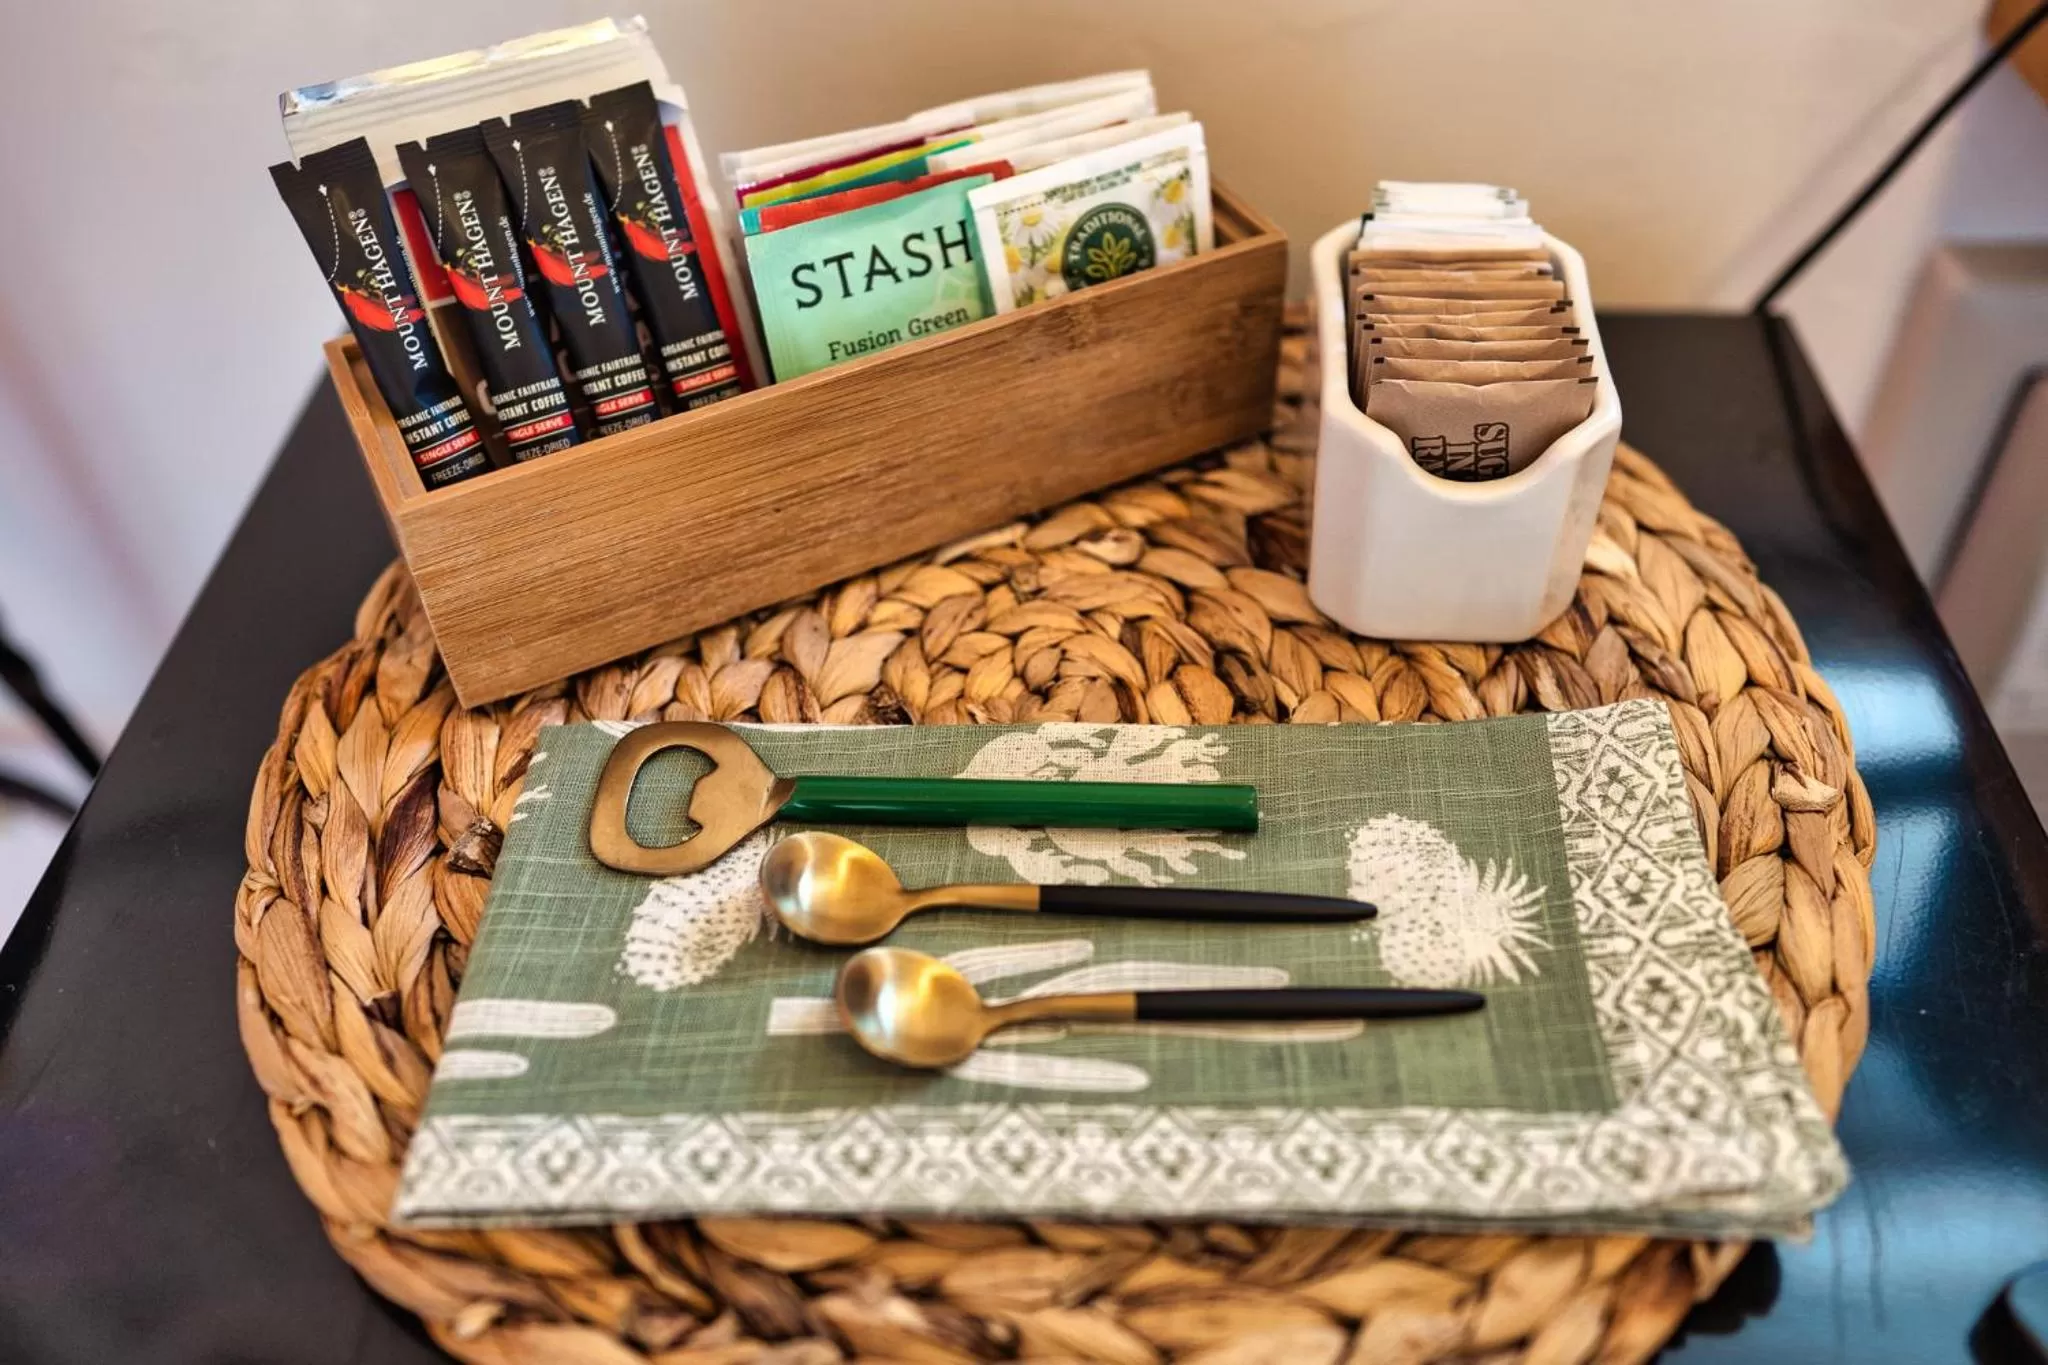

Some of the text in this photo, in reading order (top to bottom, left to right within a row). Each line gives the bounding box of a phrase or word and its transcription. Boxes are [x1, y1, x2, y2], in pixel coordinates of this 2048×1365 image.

[567, 251, 606, 328] MOUNT
[660, 226, 699, 301] MOUNT
[791, 219, 973, 310] STASH
[384, 293, 428, 371] MOUNT
[481, 273, 521, 351] MOUNT
[828, 307, 970, 361] Fusion Green
[517, 377, 561, 398] FAIRTRADE
[531, 391, 566, 412] COFFEE
[614, 368, 647, 388] COFFEE
[617, 392, 645, 410] SERVE
[535, 414, 563, 432] SERVE
[1474, 422, 1509, 480] SUG
